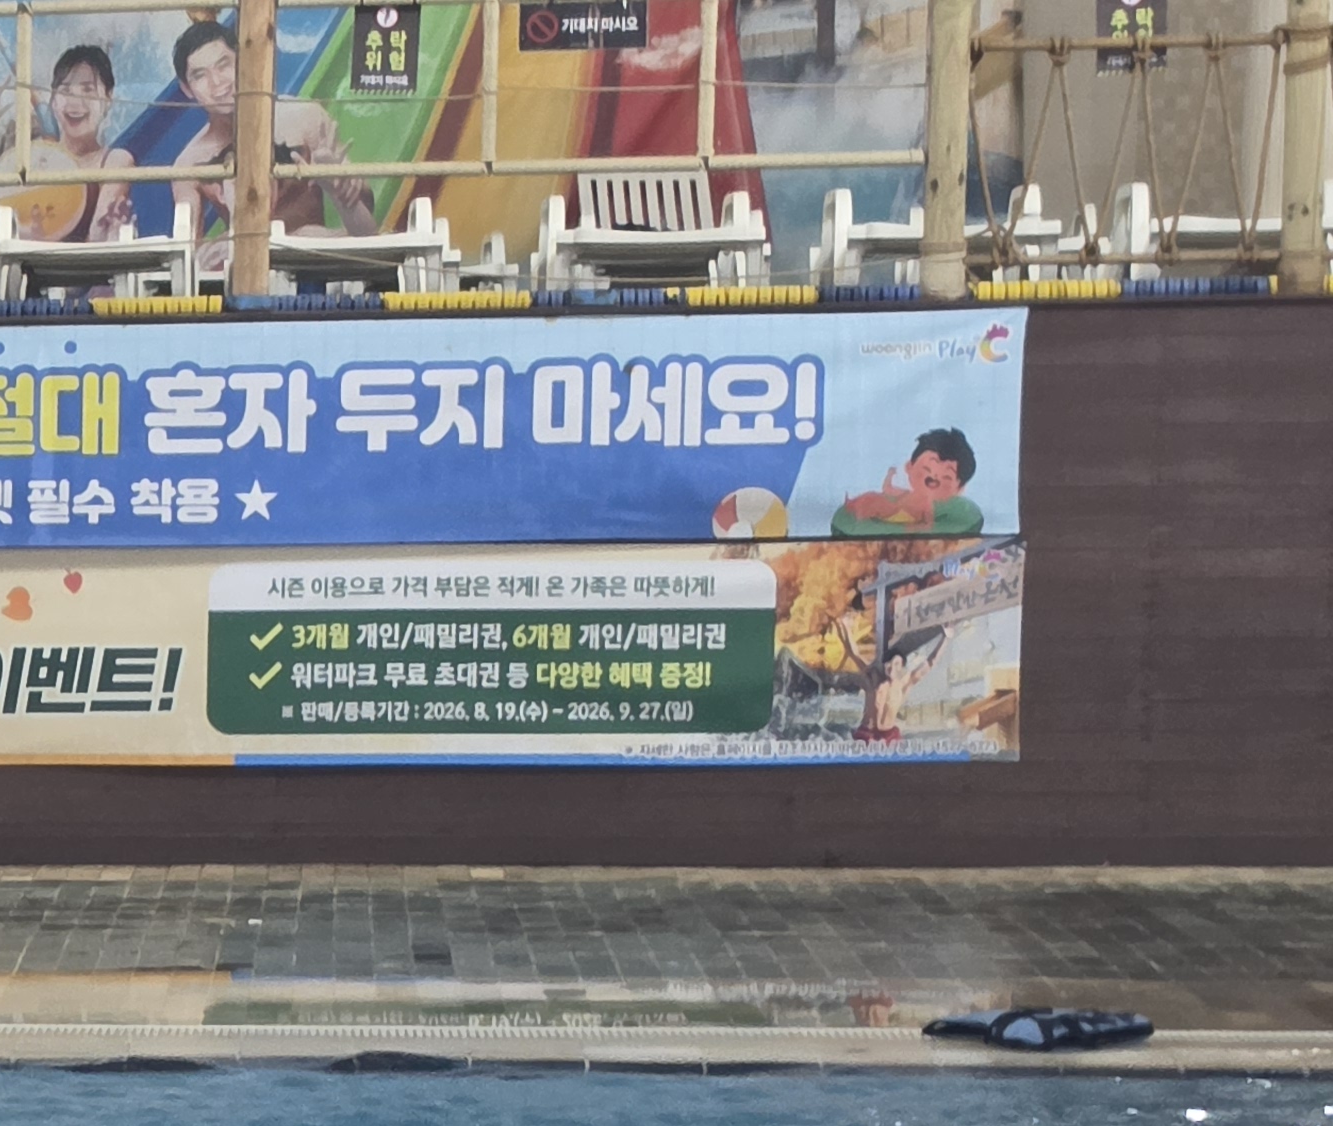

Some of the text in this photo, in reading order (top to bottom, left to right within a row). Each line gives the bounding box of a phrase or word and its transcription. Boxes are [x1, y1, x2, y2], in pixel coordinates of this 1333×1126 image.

[562, 16, 638, 33] 기대지 마시오
[144, 368, 317, 454] 혼자
[335, 364, 504, 452] 두지
[532, 360, 817, 448] 마세요!
[28, 479, 116, 524] 필수
[130, 478, 221, 524] 착용
[268, 576, 716, 598] 시즌 이용으로 가격 부담은 적게! 온 가족은 따뜻하게!
[291, 622, 726, 651] 3개월 개인/패밀리권, 6개월 개인/패밀리권
[291, 662, 712, 689] 워터파크 무료 초대권 등 다양한 혜택 증정!
